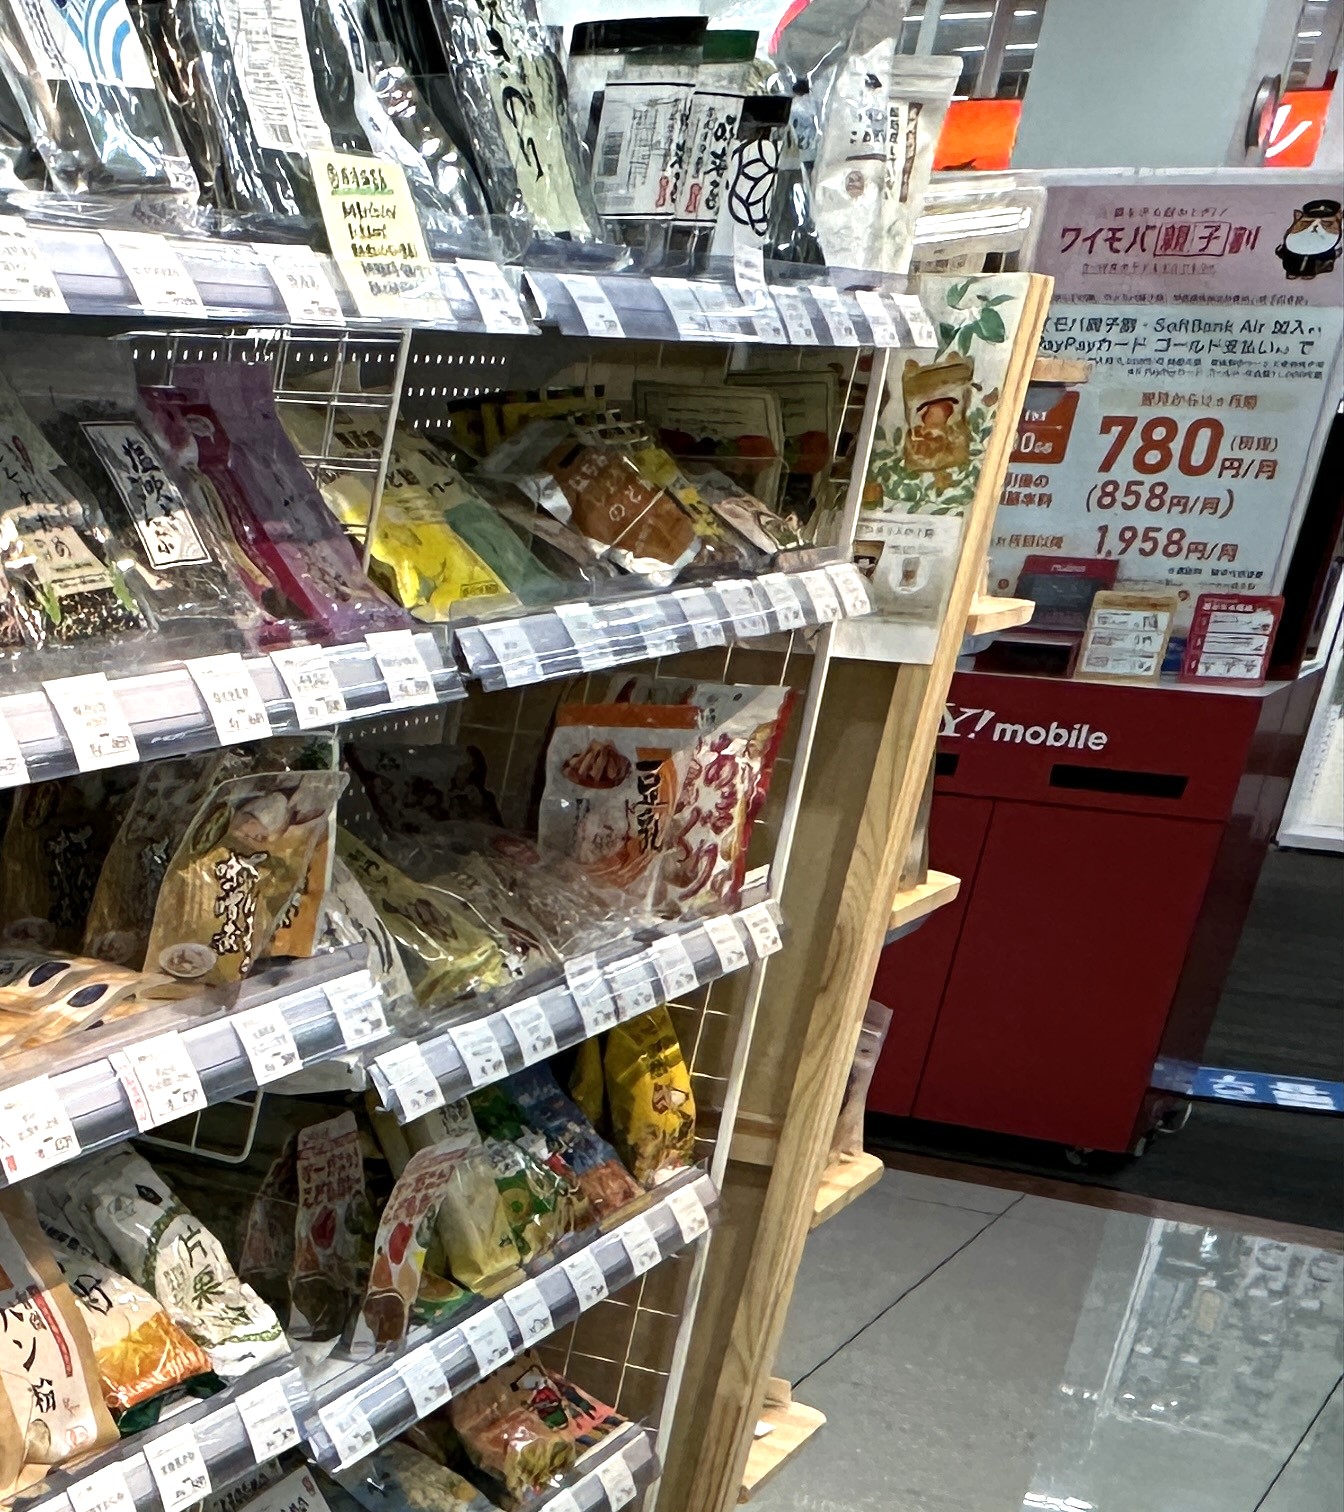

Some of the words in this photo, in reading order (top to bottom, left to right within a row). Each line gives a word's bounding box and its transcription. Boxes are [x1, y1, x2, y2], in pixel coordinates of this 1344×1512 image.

[1098, 415, 1225, 477] 780
[1218, 459, 1278, 480] 円/月
[1085, 479, 1235, 520] (858円/月)
[1096, 523, 1239, 563] 1,958円/月
